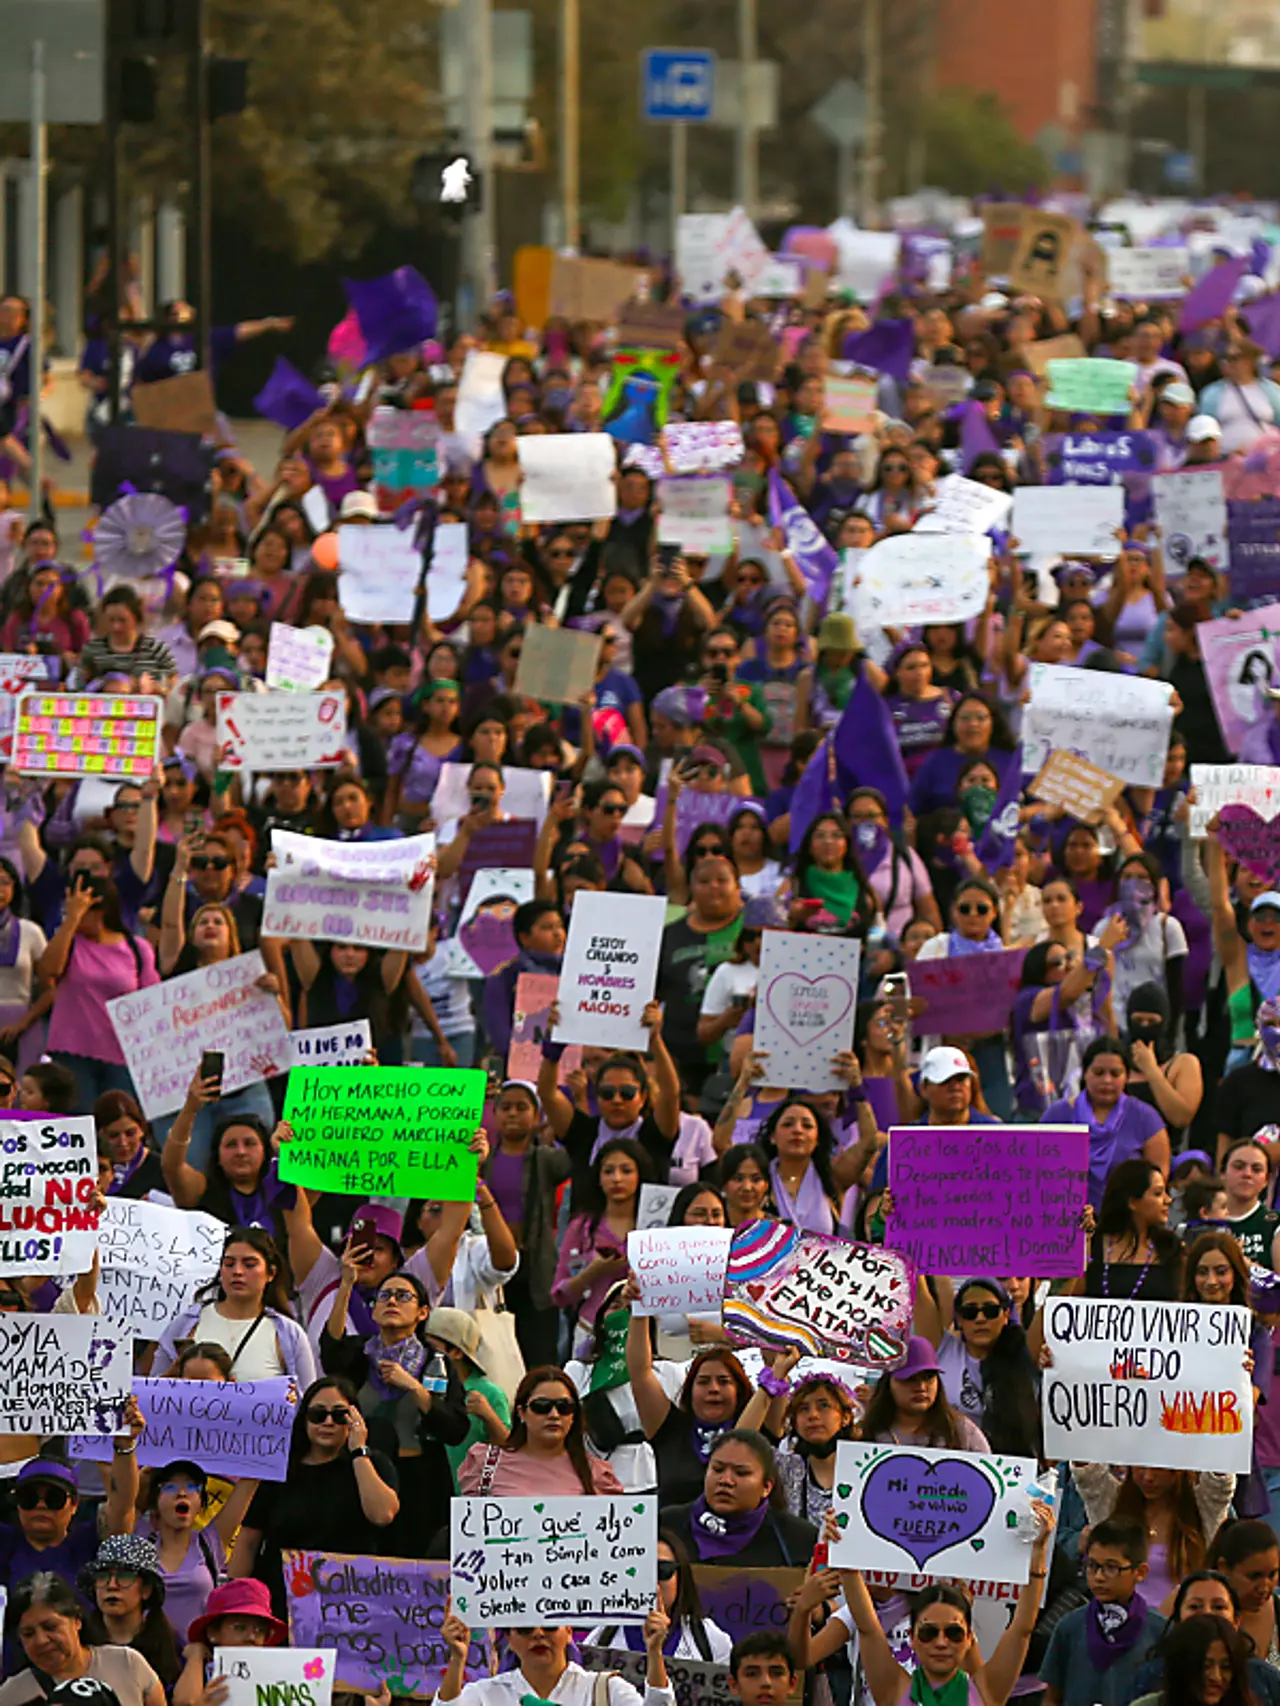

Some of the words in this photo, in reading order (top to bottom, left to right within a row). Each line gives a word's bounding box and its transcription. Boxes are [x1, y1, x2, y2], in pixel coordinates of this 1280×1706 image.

[591, 936, 627, 950] ESTOY
[586, 949, 639, 965] CRIANDO
[578, 974, 636, 989] HOMBRES
[590, 990, 612, 1001] NO
[578, 1001, 631, 1017] MACHOS
[347, 1083, 421, 1099] MARCHO
[426, 1082, 466, 1097] CON
[290, 1105, 317, 1122] MI
[320, 1105, 411, 1122] HERMANA,
[417, 1106, 481, 1121] PORQUE
[40, 1125, 85, 1150] Son
[292, 1127, 315, 1143] NO
[322, 1125, 384, 1141] QUIERO
[393, 1128, 472, 1145] MARCHAR
[289, 1148, 360, 1169] MAÑANA
[369, 1151, 400, 1169] POR
[407, 1150, 459, 1171] ELLA
[898, 1136, 931, 1161] Que
[938, 1137, 959, 1157] los
[965, 1137, 1001, 1164] ojos
[1006, 1136, 1028, 1157] de
[4, 1157, 91, 1184] provocan
[895, 1163, 1012, 1188] Desaparecidas
[1018, 1165, 1032, 1181] te
[45, 1177, 95, 1206] NO
[341, 1172, 396, 1194] #8M
[915, 1187, 938, 1209] tus
[1004, 1194, 1012, 1215] y
[1018, 1189, 1031, 1205] el
[1040, 1189, 1083, 1205] llanto
[913, 1218, 938, 1229] sus
[943, 1210, 1004, 1229] madres
[1010, 1213, 1034, 1227] NO
[1018, 1233, 1072, 1257] Dormir
[812, 1249, 851, 1285] las
[850, 1280, 862, 1295] y
[865, 1284, 900, 1313] lxs
[795, 1268, 833, 1302] que
[835, 1299, 882, 1329] nos
[773, 1285, 866, 1343] FALTAN
[1052, 1302, 1135, 1344] QUIERO
[1142, 1307, 1200, 1343] VIVIR
[1207, 1311, 1247, 1346] SIN
[35, 1324, 61, 1354] LA
[70, 1360, 104, 1382] DE
[1113, 1347, 1181, 1380] MIEDO
[17, 1379, 92, 1398] HOMBRE
[151, 1395, 183, 1416] UN
[190, 1397, 243, 1427] GOL,
[251, 1402, 292, 1430] QUE
[1050, 1381, 1147, 1431] QUIERO
[1160, 1390, 1239, 1432] VIVIR
[41, 1415, 87, 1433] HIJA
[183, 1427, 288, 1457] INJUSTICIA
[887, 1478, 908, 1492] Mi
[917, 1481, 968, 1497] miedo
[908, 1500, 925, 1510] se
[596, 1502, 633, 1542] algo
[893, 1518, 961, 1536] FUERZA
[501, 1548, 533, 1566] tan
[610, 1545, 646, 1560] como
[311, 1558, 410, 1596] Calladita
[475, 1569, 528, 1595] volver
[542, 1577, 552, 1589] a
[561, 1574, 590, 1589] casa
[321, 1601, 368, 1624] me
[535, 1597, 571, 1613] como
[577, 1599, 592, 1613] un
[601, 1588, 657, 1614] privilegio?
[256, 1680, 316, 1706] NIÑAS
